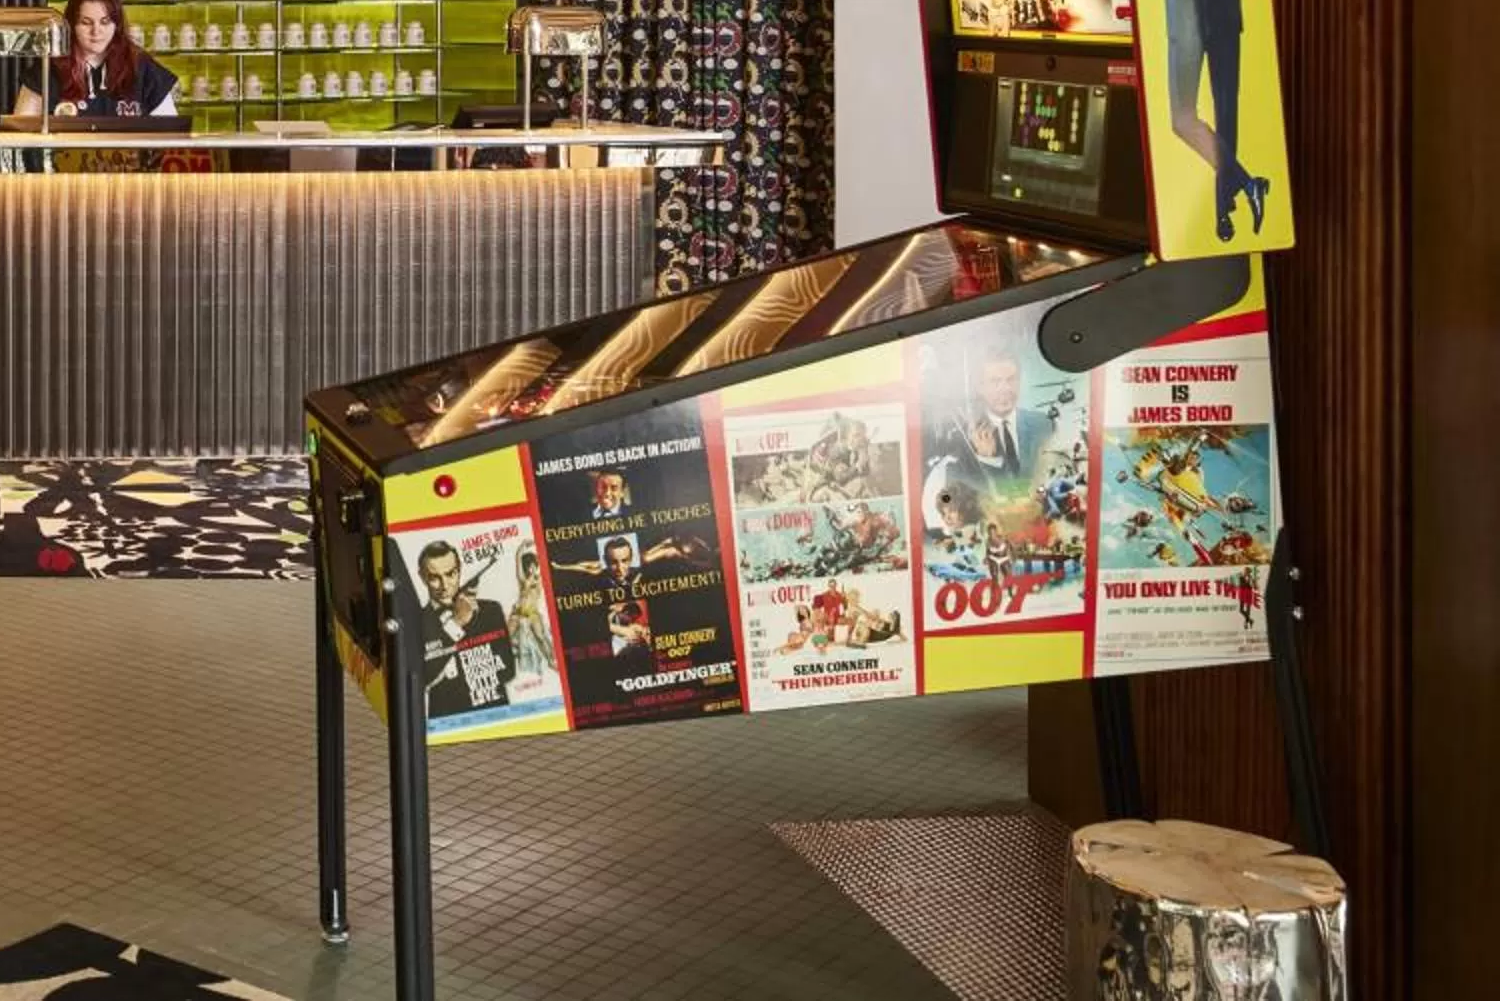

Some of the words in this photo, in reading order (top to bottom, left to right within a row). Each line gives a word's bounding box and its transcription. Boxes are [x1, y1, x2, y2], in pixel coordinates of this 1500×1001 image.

[1165, 365, 1238, 382] CONNERY
[1171, 385, 1189, 403] IS
[1128, 406, 1182, 423] JAMES
[1187, 405, 1232, 422] BOND
[536, 458, 573, 476] JAMES
[574, 453, 604, 470] BOND
[605, 451, 617, 465] IS
[617, 447, 646, 462] BACK
[648, 443, 659, 457] IN
[545, 518, 625, 542] EVERYTHING
[627, 514, 647, 529] HE
[652, 503, 711, 525] TOUCHES
[461, 532, 492, 550] JAMES
[492, 524, 519, 542] BOND
[462, 550, 473, 564] IS
[557, 591, 603, 610] TURNS
[608, 587, 625, 601] TO
[632, 571, 722, 597] EXCITEMENT!
[935, 568, 1064, 621] 007
[1104, 582, 1137, 599] YOU
[1140, 581, 1177, 598] ONLY
[1181, 580, 1210, 597] LIVE
[793, 661, 825, 676] SEAN
[826, 658, 880, 674] CONNERY
